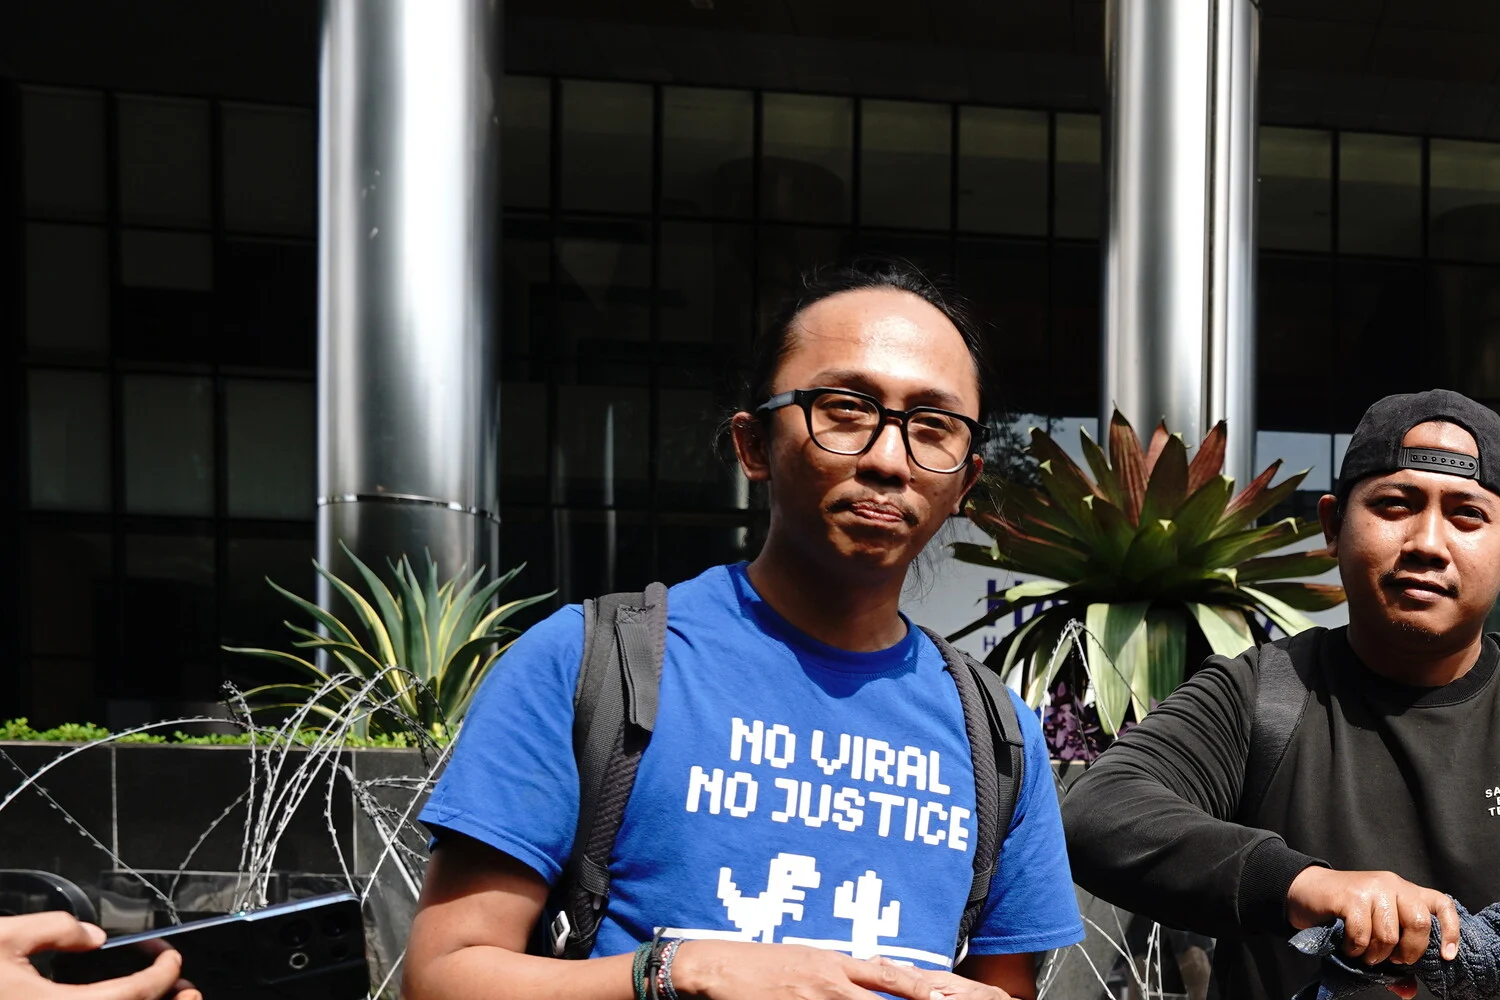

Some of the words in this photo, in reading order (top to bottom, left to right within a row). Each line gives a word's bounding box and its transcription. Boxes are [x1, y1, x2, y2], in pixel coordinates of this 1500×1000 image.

[730, 717, 796, 769] NO
[810, 729, 951, 796] VIRAL
[686, 765, 758, 818] NO
[771, 778, 971, 851] JUSTICE
